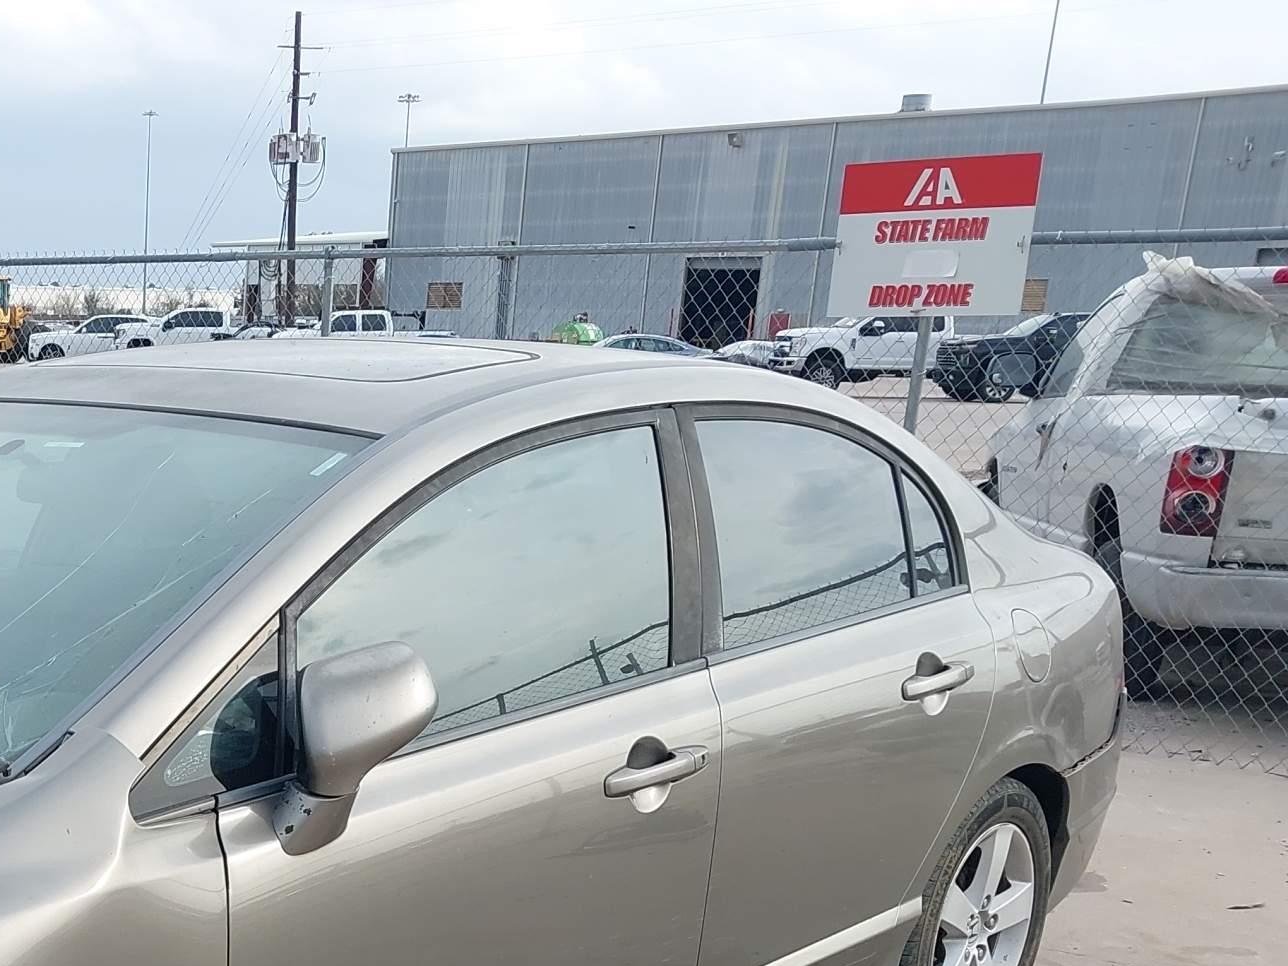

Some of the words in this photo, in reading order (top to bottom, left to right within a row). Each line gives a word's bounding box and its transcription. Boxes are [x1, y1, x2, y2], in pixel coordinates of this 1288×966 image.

[875, 218, 932, 244] STATE
[933, 216, 990, 243] FARM
[868, 284, 922, 308] DROP
[923, 283, 974, 307] ZONE
